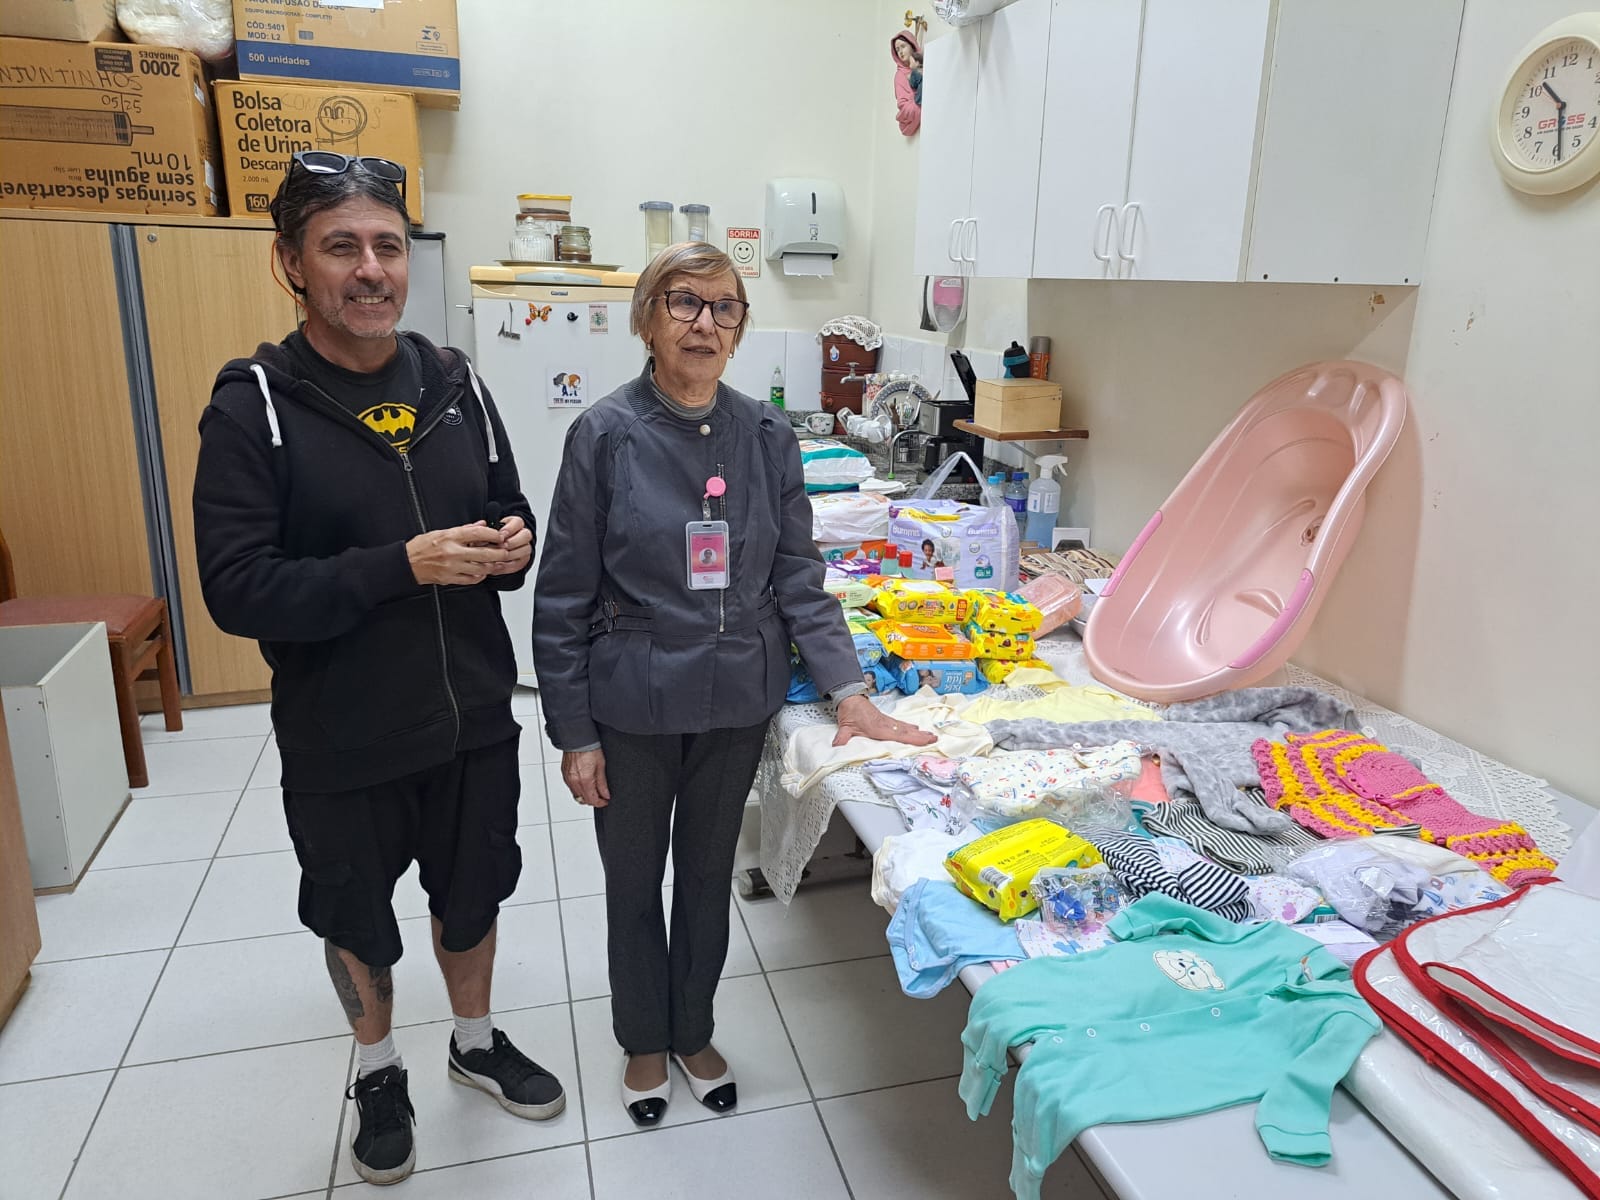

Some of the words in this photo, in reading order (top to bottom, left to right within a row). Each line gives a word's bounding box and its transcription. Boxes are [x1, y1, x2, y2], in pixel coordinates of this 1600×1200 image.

[138, 50, 179, 61] UNIDADES
[248, 52, 265, 62] 500
[268, 54, 310, 66] unidades
[1562, 53, 1578, 68] 12
[1587, 56, 1592, 69] 1
[140, 58, 181, 78] 2000
[1544, 66, 1556, 80] 11
[1529, 85, 1542, 98] 10
[232, 90, 282, 110] Bolsa
[1522, 106, 1530, 119] 9
[235, 112, 312, 134] Coletora
[1588, 116, 1597, 128] 4
[1523, 126, 1533, 139] 8
[238, 133, 260, 152] de
[264, 134, 312, 154] Urina
[1534, 141, 1544, 154] 7
[1571, 134, 1582, 148] 5
[166, 153, 192, 171] 10
[84, 166, 150, 187] agulha
[156, 171, 194, 186] sem
[116, 184, 196, 206] Seringas
[248, 196, 268, 208] 160
[729, 230, 759, 239] SORRIA
